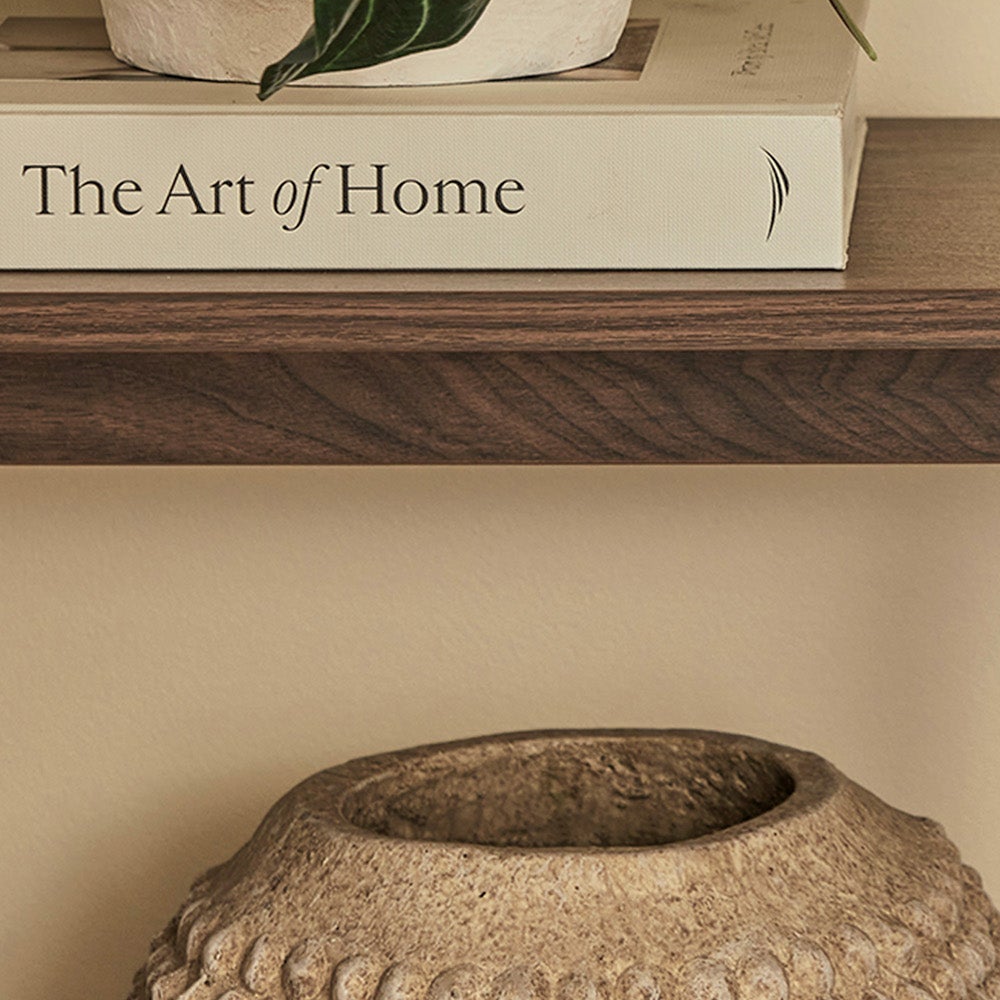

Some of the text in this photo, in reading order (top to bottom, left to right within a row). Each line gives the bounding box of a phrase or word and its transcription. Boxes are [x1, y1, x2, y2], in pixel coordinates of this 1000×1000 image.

[22, 163, 526, 231] The Art of Home
